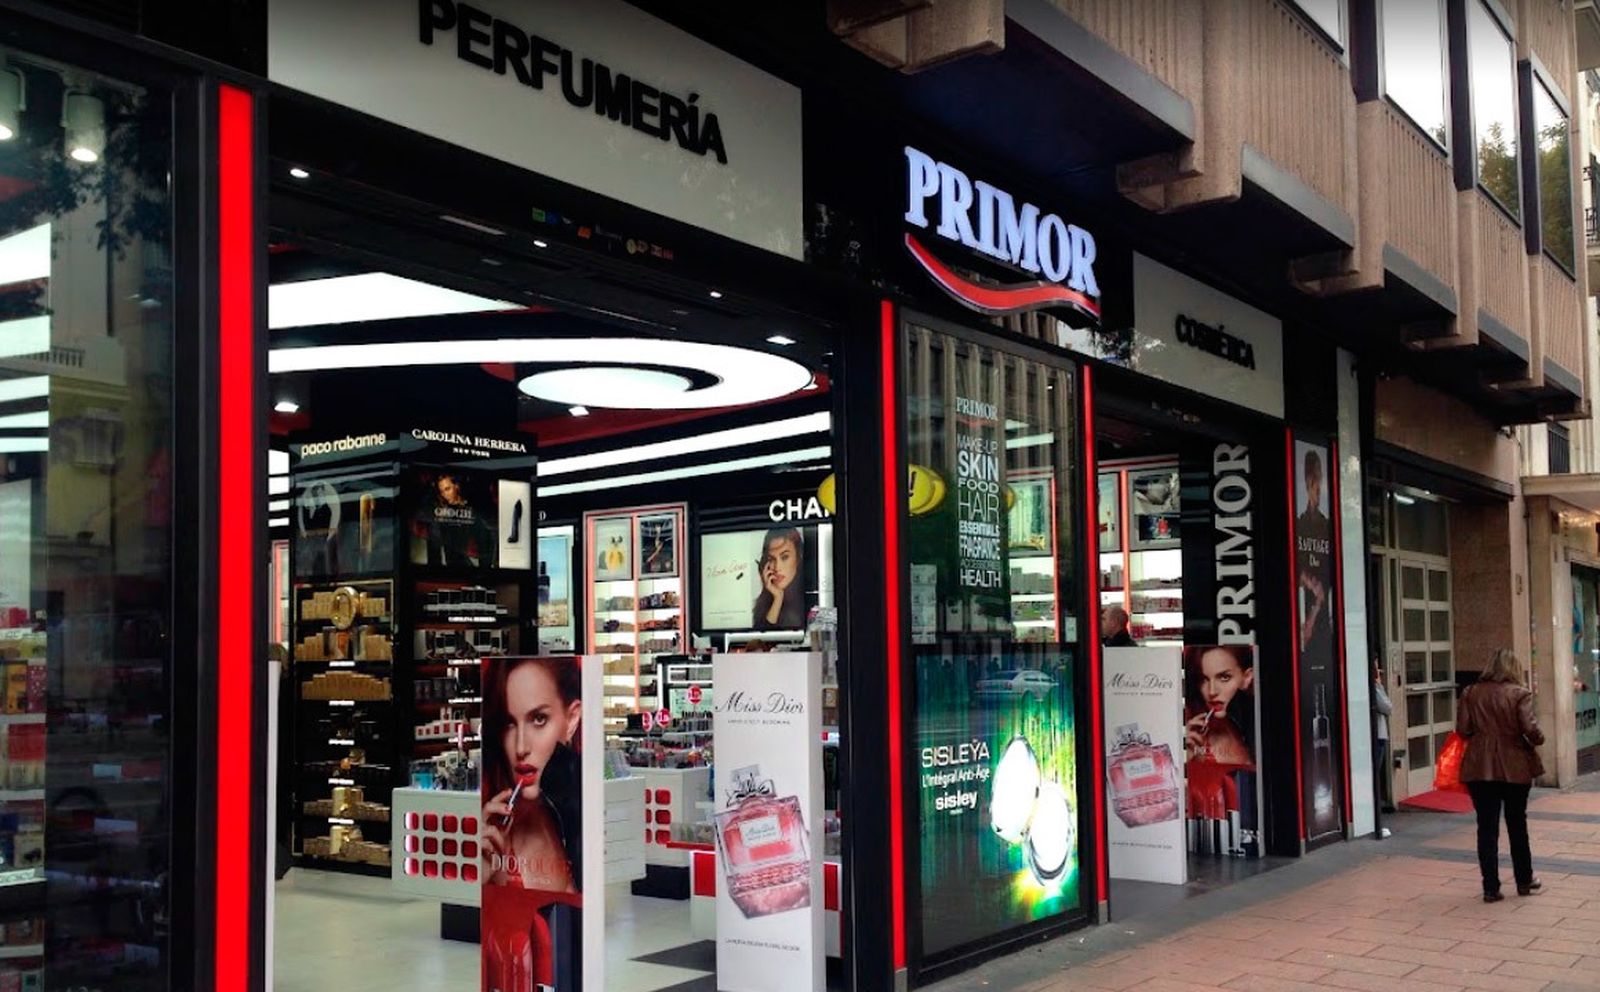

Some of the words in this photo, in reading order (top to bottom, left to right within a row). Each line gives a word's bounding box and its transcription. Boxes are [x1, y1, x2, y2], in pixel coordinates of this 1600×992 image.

[419, 0, 728, 165] PERFUMERÍA
[904, 146, 1101, 298] PRIMOR
[1175, 314, 1255, 371] COSMÉTICA
[956, 397, 998, 421] PRIMOR
[301, 441, 332, 460] paco
[333, 433, 386, 451] rabanne
[412, 428, 472, 446] CAROLINA
[474, 436, 527, 453] HERRERA
[958, 450, 999, 482] SKIN
[958, 478, 999, 494] FOOD
[769, 496, 830, 522] CHA
[958, 489, 999, 524] HAIR
[1213, 442, 1256, 645] PRIMOR
[960, 569, 1002, 588] HEALTH
[1106, 672, 1140, 688] Miss
[1141, 673, 1174, 689] Dior
[714, 691, 762, 713] Miss
[763, 692, 805, 713] Dior
[935, 789, 977, 811] sisley
